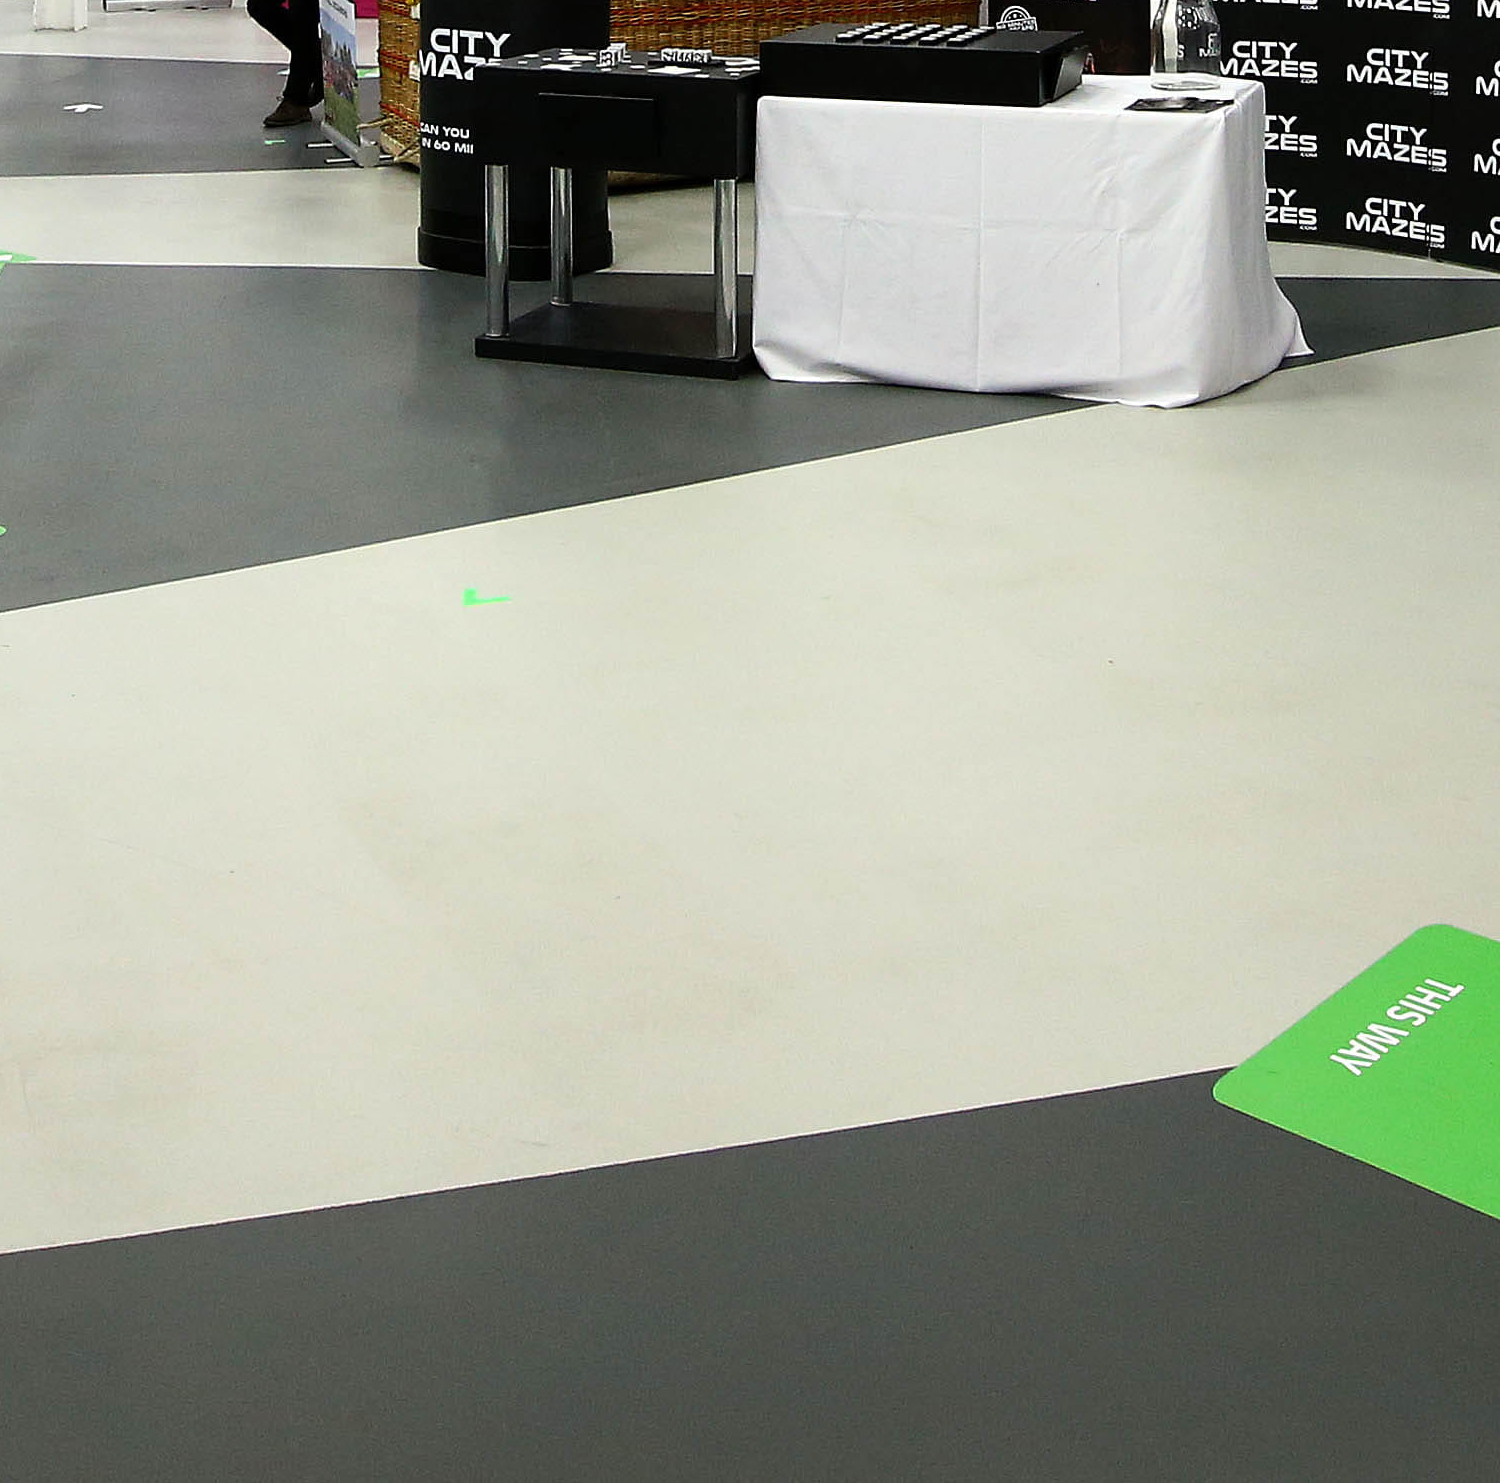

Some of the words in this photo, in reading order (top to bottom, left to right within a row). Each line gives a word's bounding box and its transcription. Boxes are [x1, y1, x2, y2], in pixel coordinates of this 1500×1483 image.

[430, 28, 511, 57] CITY
[433, 140, 451, 151] 60
[442, 126, 470, 139] YOU
[1385, 978, 1465, 1027] THIS
[1329, 1022, 1410, 1077] WAY
